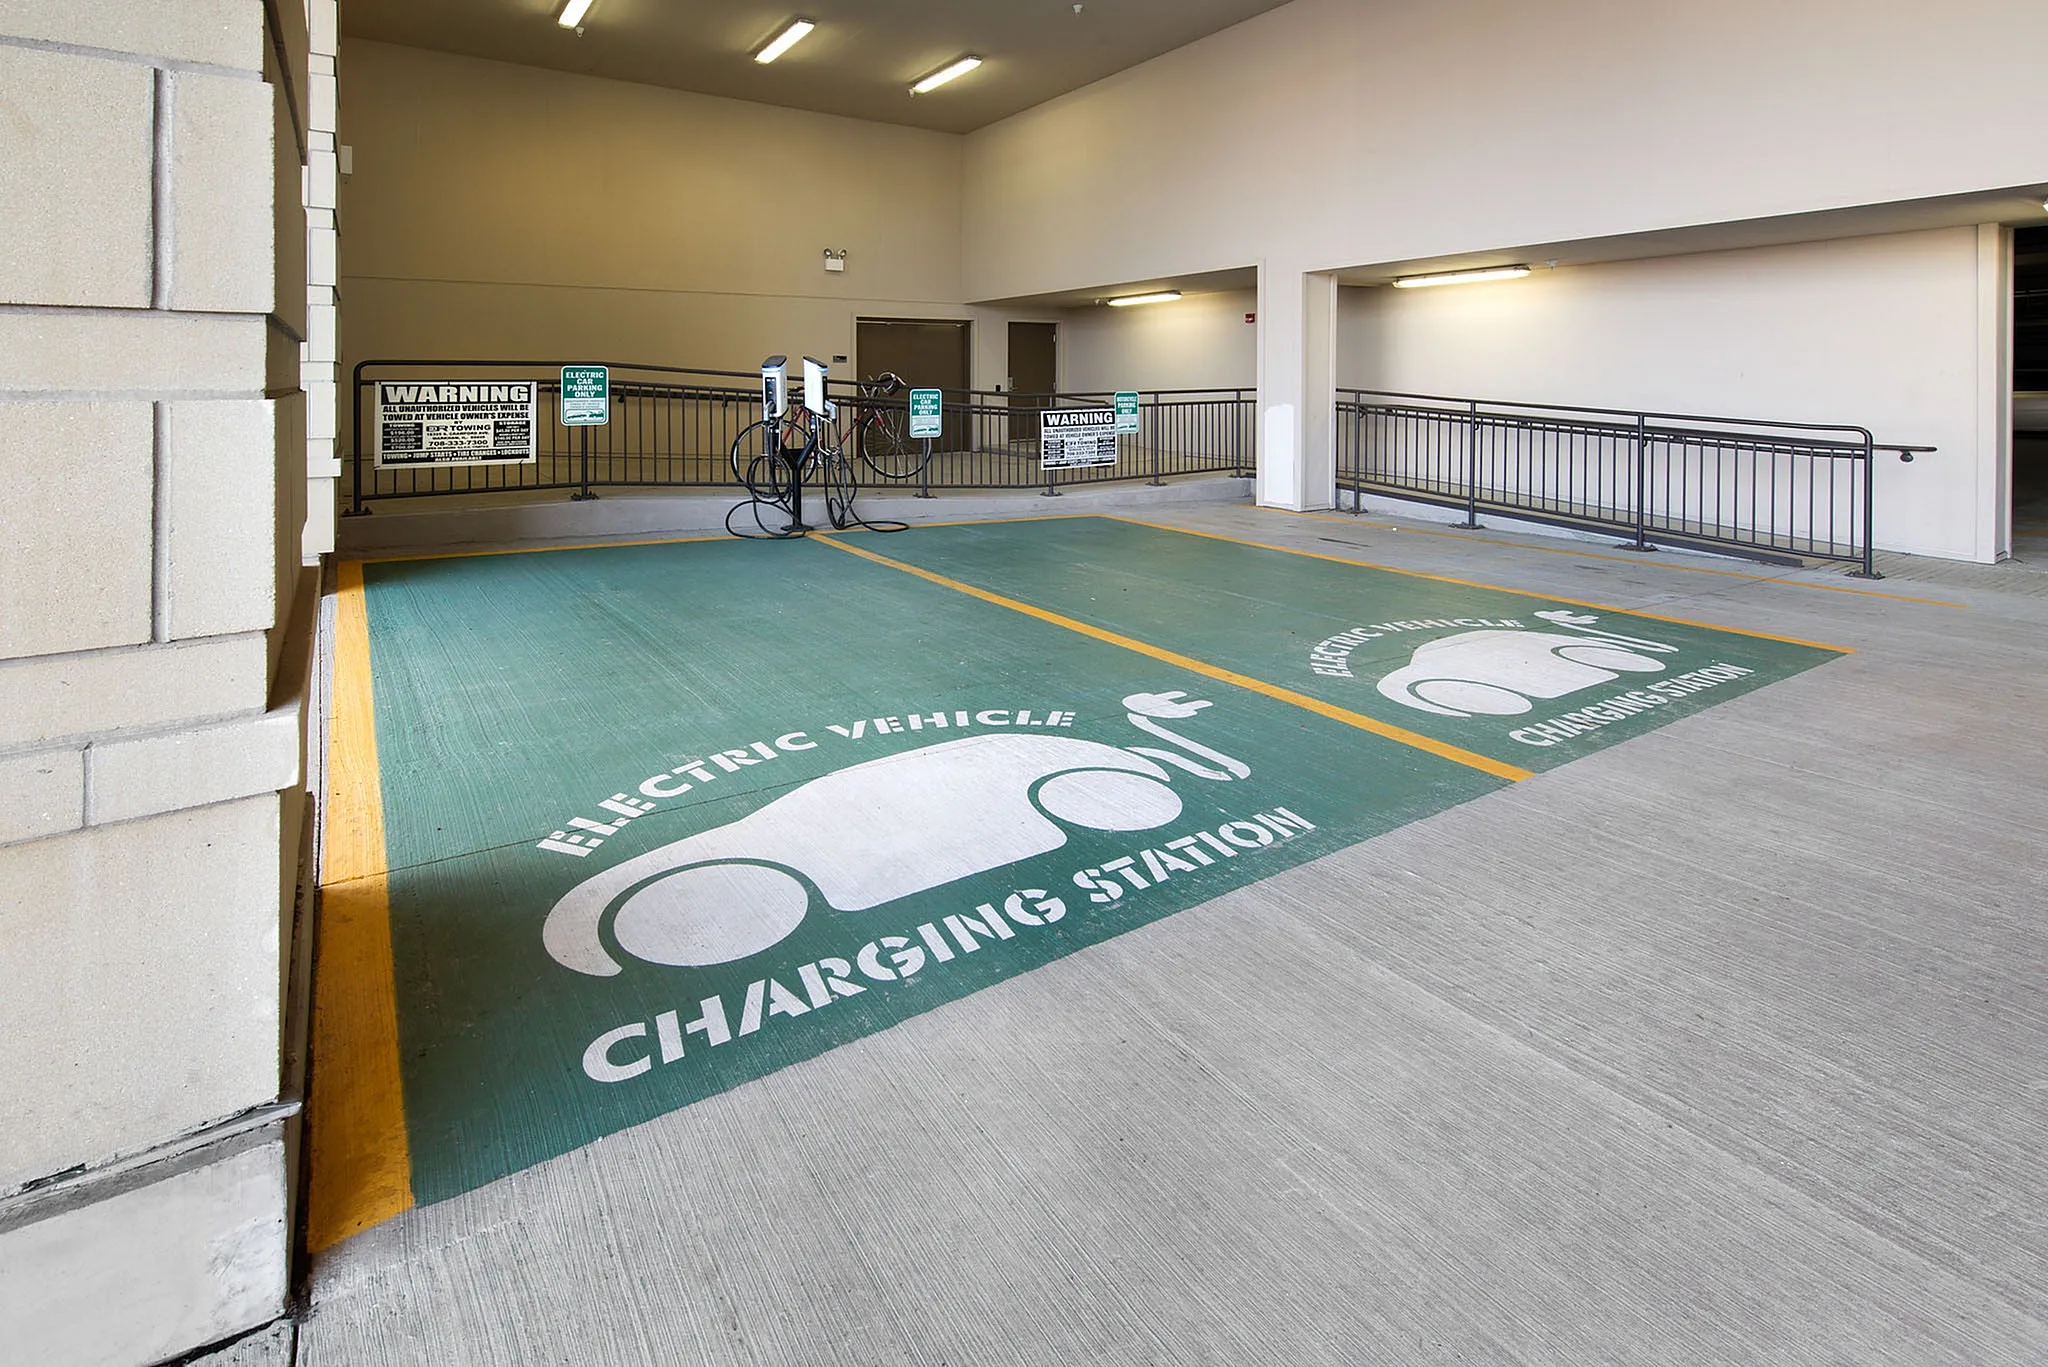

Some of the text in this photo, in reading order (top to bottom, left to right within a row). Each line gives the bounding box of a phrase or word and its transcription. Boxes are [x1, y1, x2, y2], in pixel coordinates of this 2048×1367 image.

[386, 386, 528, 402] WARNING
[1046, 412, 1112, 426] WARNING
[1310, 617, 1526, 679] ELECTRIC VEHICLE
[1508, 661, 1755, 748] CHARGING STATION
[536, 709, 1077, 858] ELECTRIC VEHICLE
[581, 806, 1317, 1083] CHARGING STATION
